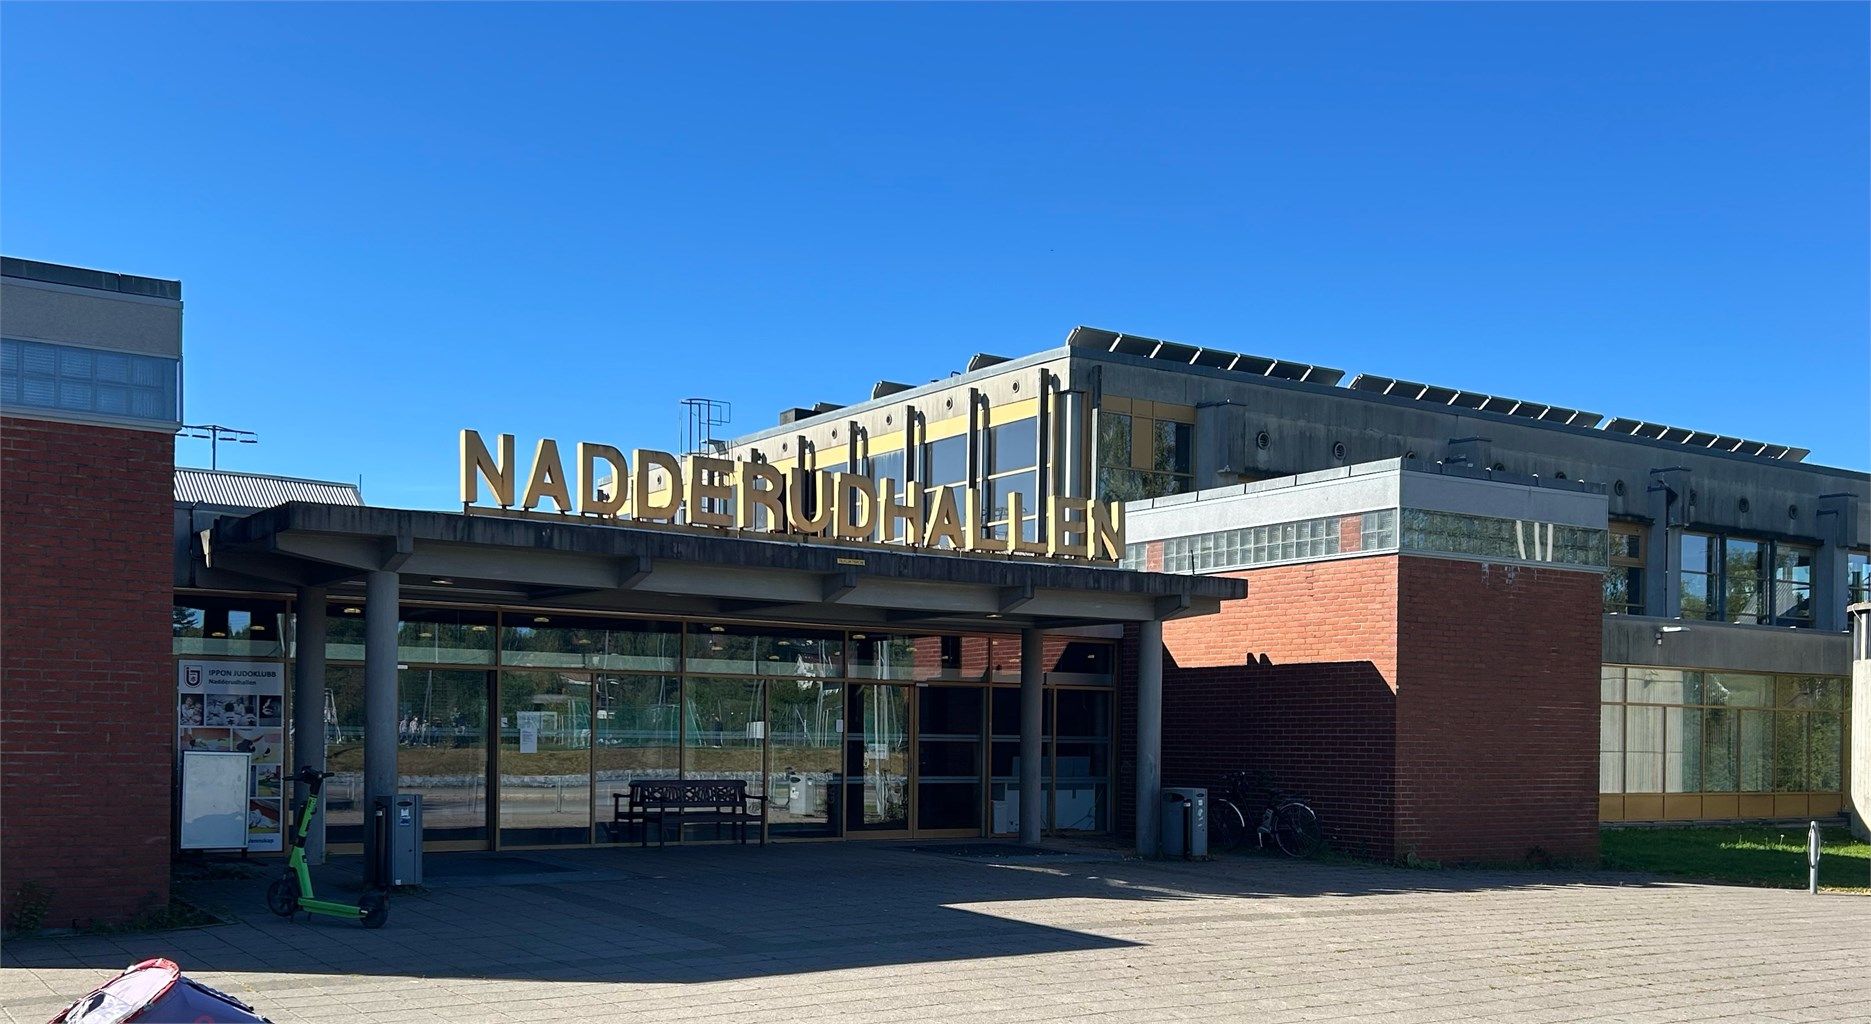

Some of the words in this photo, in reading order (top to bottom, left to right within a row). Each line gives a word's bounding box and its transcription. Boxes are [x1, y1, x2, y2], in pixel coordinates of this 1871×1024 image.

[460, 429, 1126, 561] NADDERUDHALLEN
[208, 669, 232, 677] IPPON
[233, 670, 277, 678] JUDOKLUBB
